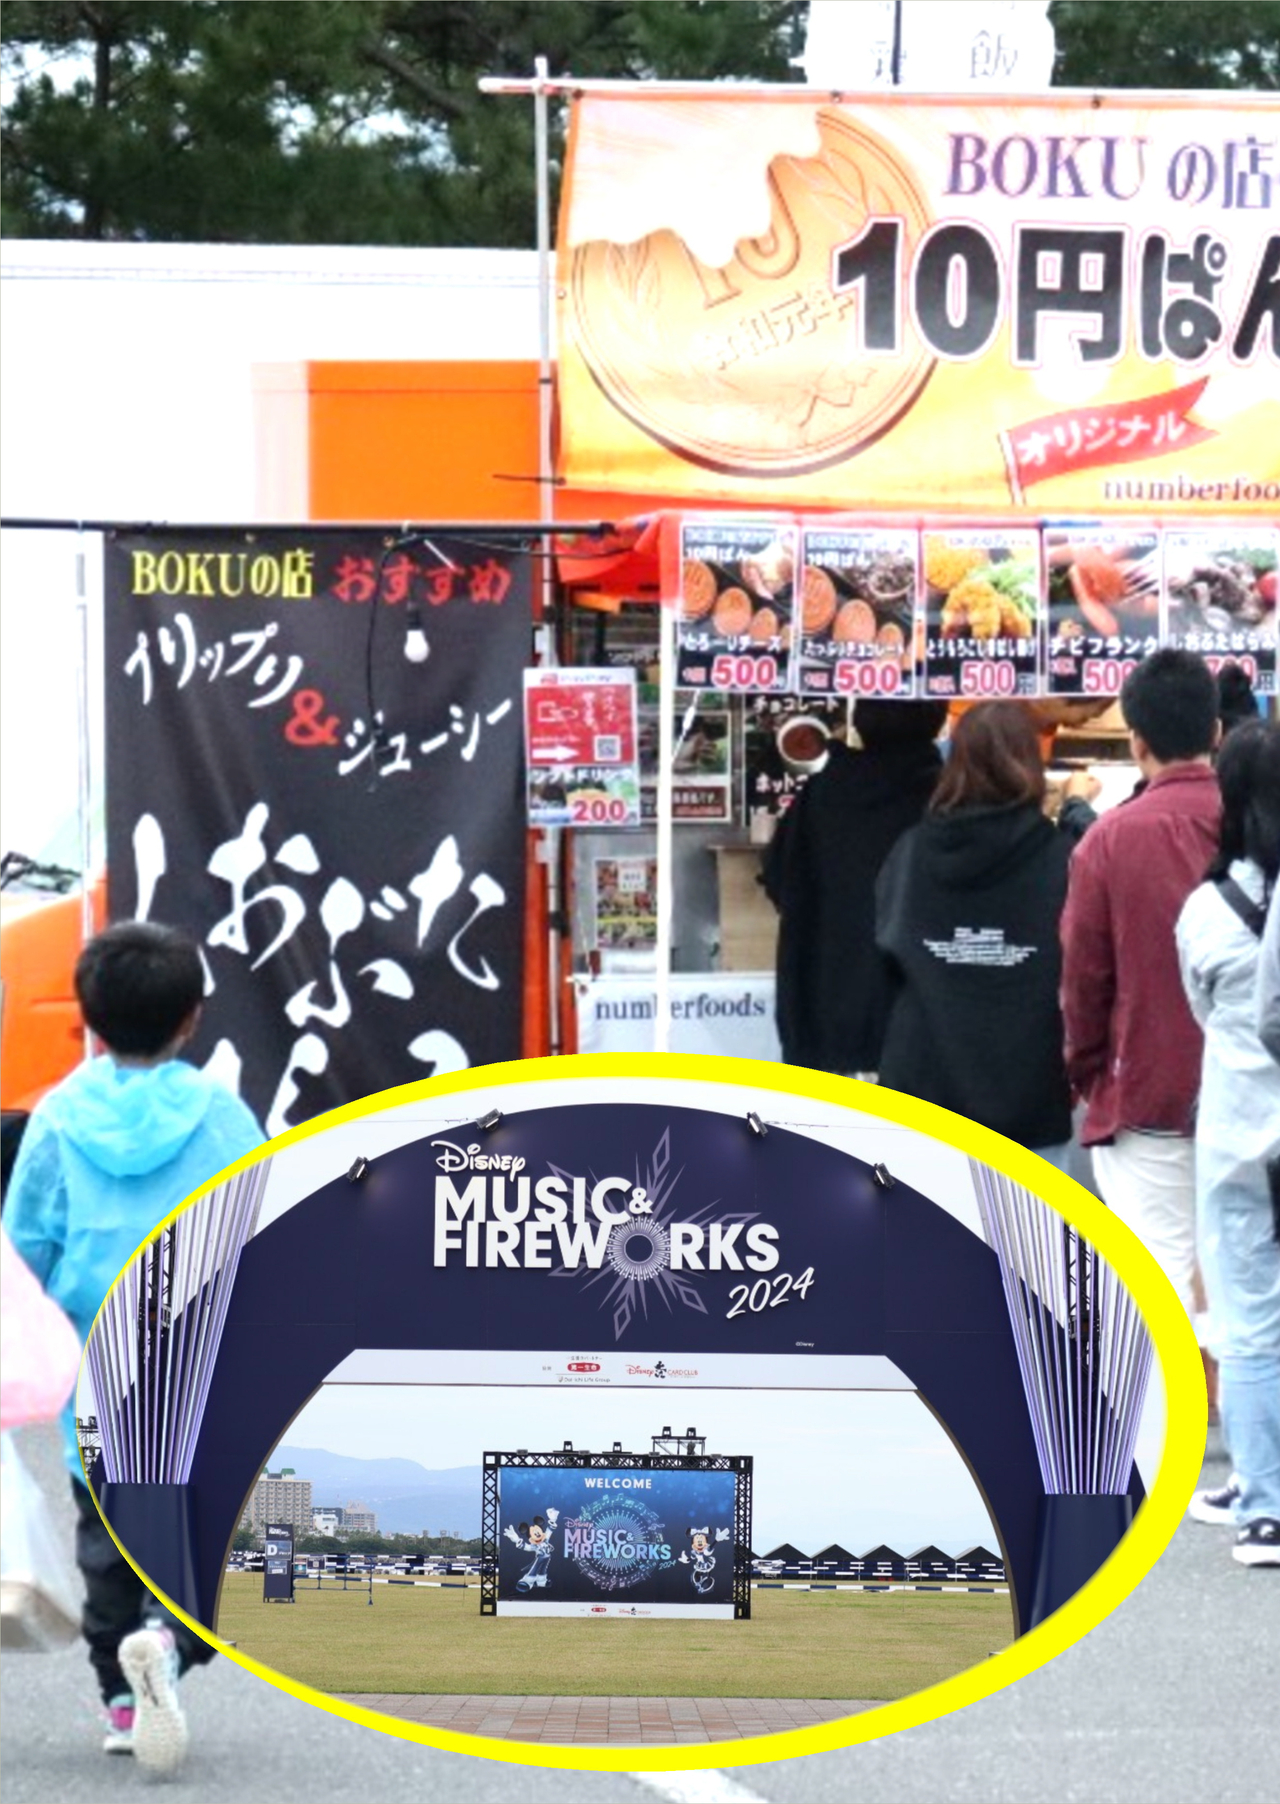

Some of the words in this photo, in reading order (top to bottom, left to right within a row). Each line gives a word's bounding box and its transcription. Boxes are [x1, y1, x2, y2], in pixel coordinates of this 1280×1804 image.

[944, 134, 1147, 198] BOKU
[1018, 411, 1185, 465] オリジナル
[132, 549, 314, 599] BOKUの店
[332, 556, 511, 604] おすすめ
[1050, 635, 1158, 657] チビフランク
[713, 656, 776, 688] 500
[835, 661, 900, 693] 500
[962, 660, 1015, 694] 500
[285, 689, 341, 745] &
[338, 697, 512, 776] ジューシー
[573, 799, 626, 821] 200
[434, 1176, 633, 1226] MUSIC
[628, 1186, 654, 1215] &
[725, 1266, 815, 1320] 2024
[584, 1477, 653, 1490] WELCOME
[267, 1544, 278, 1556] D
[563, 1543, 672, 1560] FIREWORKS
[564, 1528, 628, 1545] MUSIC
[626, 1531, 635, 1542] &
